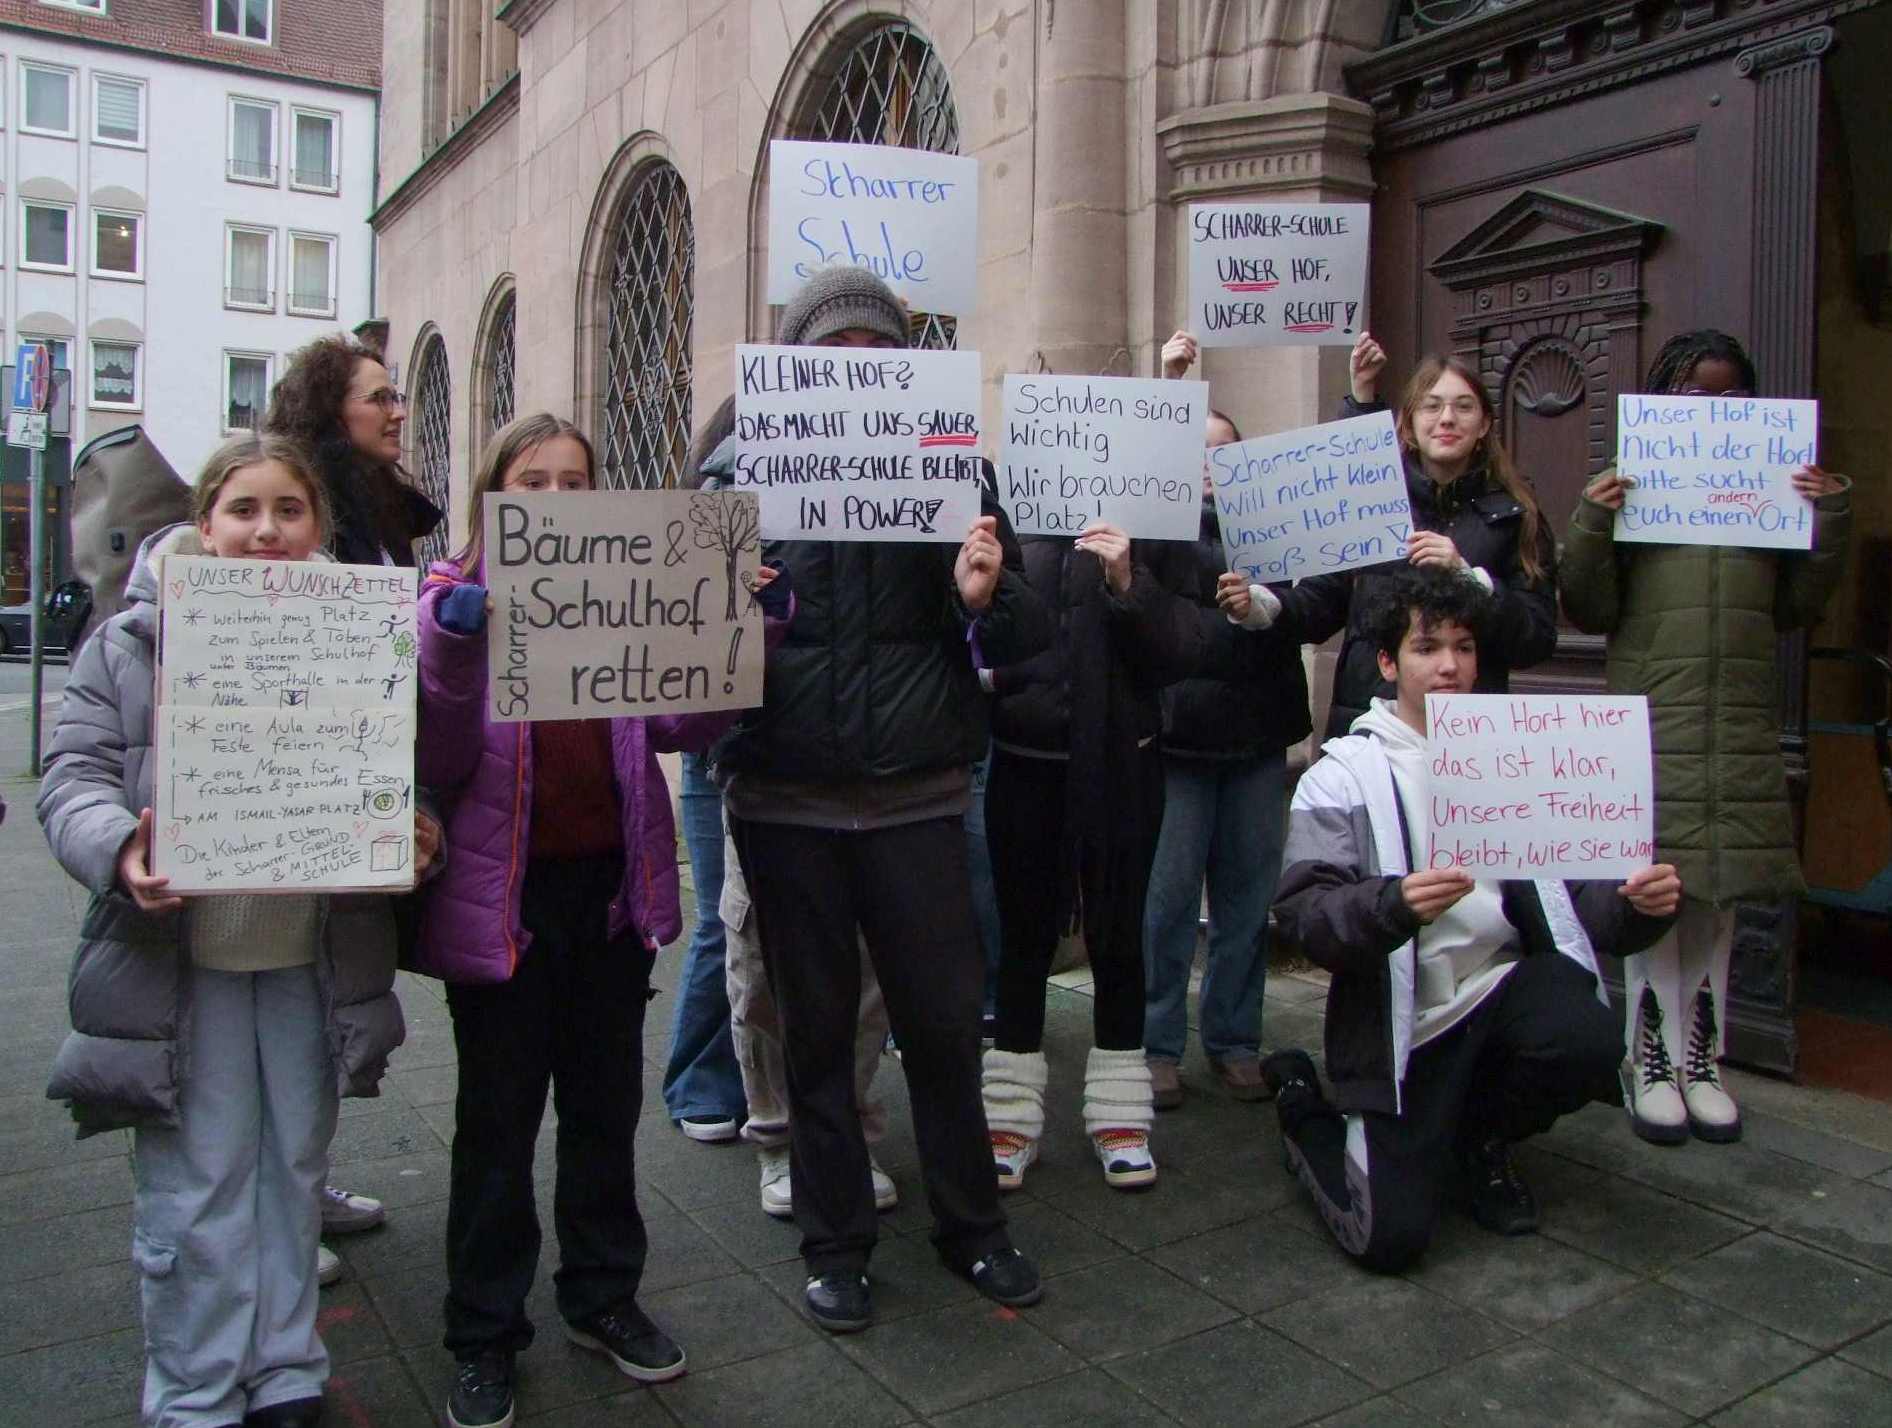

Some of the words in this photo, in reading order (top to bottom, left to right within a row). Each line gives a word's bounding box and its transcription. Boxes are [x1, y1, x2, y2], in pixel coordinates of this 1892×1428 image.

[1194, 211, 1349, 242] SCHARRER-SCHULE
[1217, 256, 1279, 282] UNSER
[1292, 258, 1330, 283] HOF,
[1204, 302, 1266, 330] UNSER
[741, 354, 839, 395] KLEINER
[847, 360, 914, 391] HOF?
[1015, 384, 1123, 416] Schulen
[1134, 395, 1190, 424] sind
[1623, 397, 1697, 428] Unser
[1710, 400, 1755, 424] Hof
[1764, 408, 1797, 432] ist
[737, 412, 781, 441] DAS
[784, 410, 851, 441] MACHT
[863, 410, 914, 437] UNS
[918, 409, 979, 438] SAUER,
[1712, 432, 1760, 460] der
[1767, 435, 1814, 464] Hort
[736, 453, 913, 487] SCHARRER-SCHULE
[922, 453, 983, 488] BLEIBT,
[1008, 465, 1051, 499] Wir
[1060, 465, 1192, 503] brauchen
[1277, 465, 1338, 505] nicht
[1694, 470, 1773, 490] sucht
[800, 496, 826, 530] IN
[845, 496, 944, 534] POWER!
[1226, 520, 1294, 549] Unser
[1303, 498, 1349, 531] Hof
[1358, 498, 1409, 520] muss
[1688, 508, 1751, 526] einen
[1758, 505, 1808, 531] Ort
[498, 503, 652, 567] Bäume
[664, 520, 688, 567] &
[188, 567, 254, 587] UNSER
[320, 606, 372, 621] Platz
[528, 577, 710, 636] Schulhof
[248, 631, 298, 649] Spielen
[303, 629, 315, 644] &
[322, 627, 370, 643] Toben
[311, 643, 380, 661] Schulhof
[213, 680, 243, 689] eine
[252, 671, 327, 694] Sporthalle
[336, 676, 348, 685] in
[355, 673, 375, 685] der
[215, 722, 256, 733] eine
[267, 716, 303, 735] Aula
[1430, 698, 1495, 739] Kein
[1510, 701, 1566, 734] Hort
[1580, 703, 1631, 728] hier
[210, 735, 254, 753] Feste
[272, 737, 324, 754] feiern
[213, 767, 245, 780] eine
[254, 758, 302, 778] Mensa
[312, 759, 340, 775] für
[1432, 748, 1482, 781] das
[1496, 745, 1534, 778] ist
[1552, 746, 1615, 781] klar,
[198, 781, 262, 799] frisches
[270, 779, 280, 791] &
[358, 769, 404, 788] Essen
[197, 812, 218, 823] AM
[320, 804, 360, 815] PLATZ
[1433, 795, 1532, 827] Unsere
[1538, 791, 1645, 821] Freiheit
[212, 833, 269, 857] Kinder
[1430, 832, 1522, 871] bleibt,
[272, 868, 285, 881] &
[301, 851, 361, 881] SCHULE
